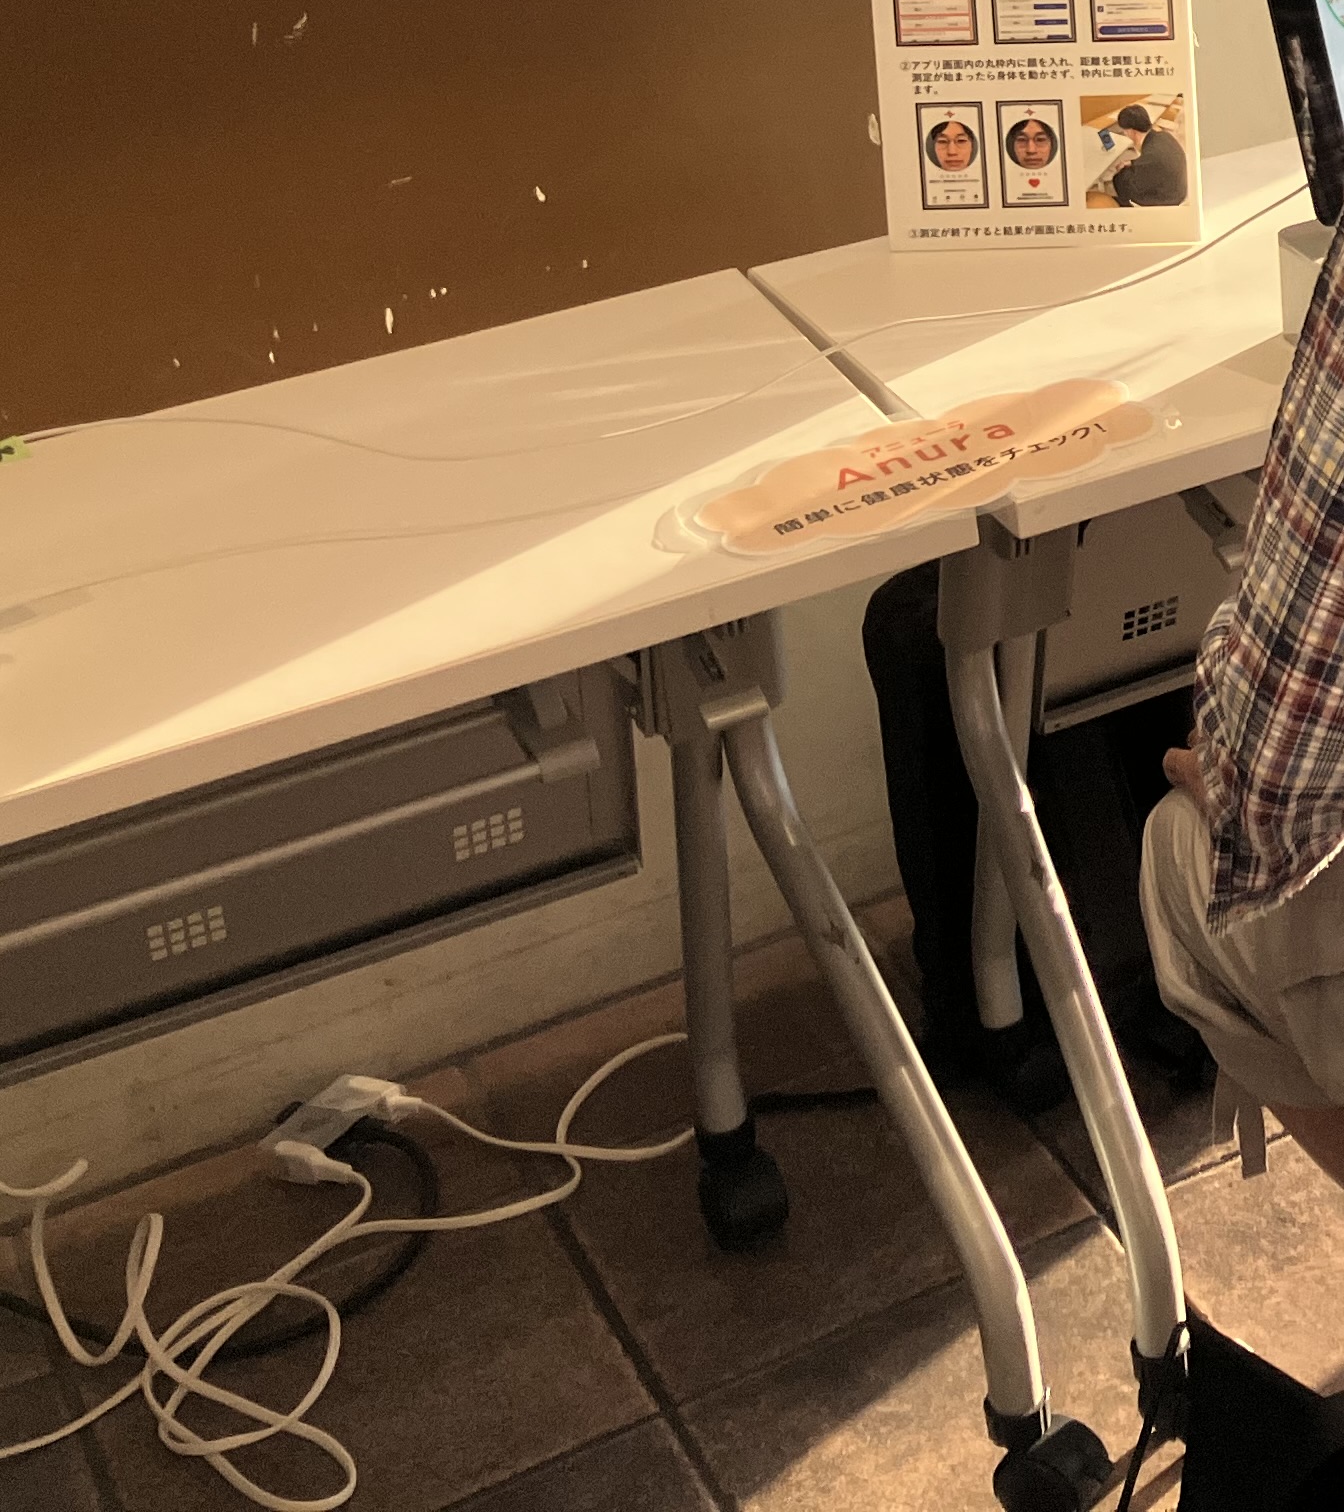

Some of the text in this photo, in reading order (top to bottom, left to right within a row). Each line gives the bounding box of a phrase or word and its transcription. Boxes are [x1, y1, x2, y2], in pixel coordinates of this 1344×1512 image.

[836, 423, 1016, 490] Anura
[860, 419, 967, 459] アニューラ
